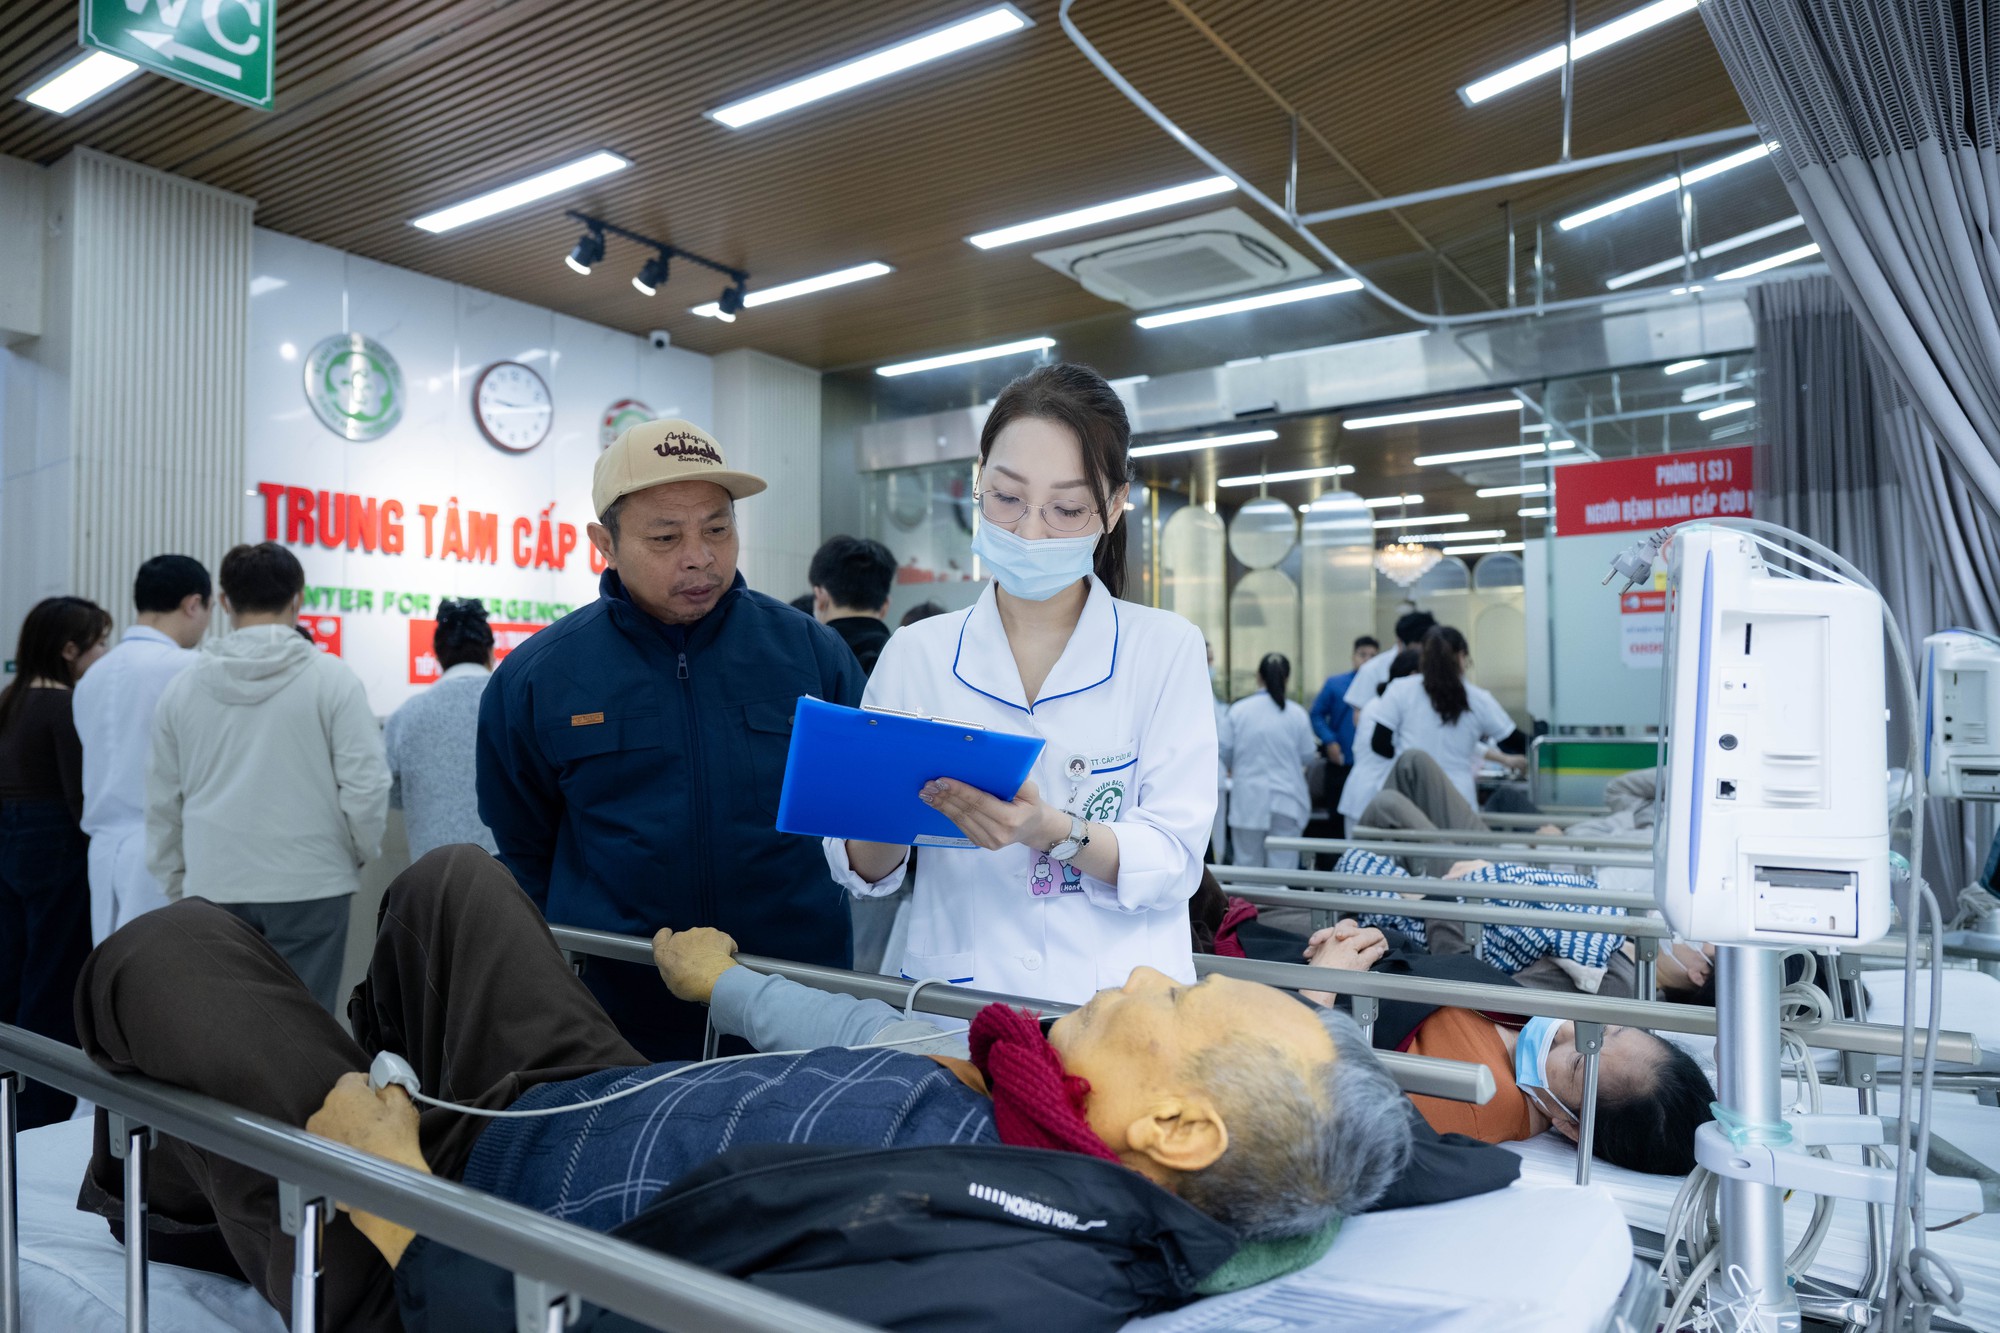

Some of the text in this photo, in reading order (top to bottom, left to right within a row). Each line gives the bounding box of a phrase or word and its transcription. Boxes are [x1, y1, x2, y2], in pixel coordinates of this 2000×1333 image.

[258, 482, 405, 555] TRUNG
[418, 496, 499, 565] TÂM
[512, 502, 577, 571] CẤP
[303, 586, 374, 612] NTER
[383, 591, 431, 614] FOR
